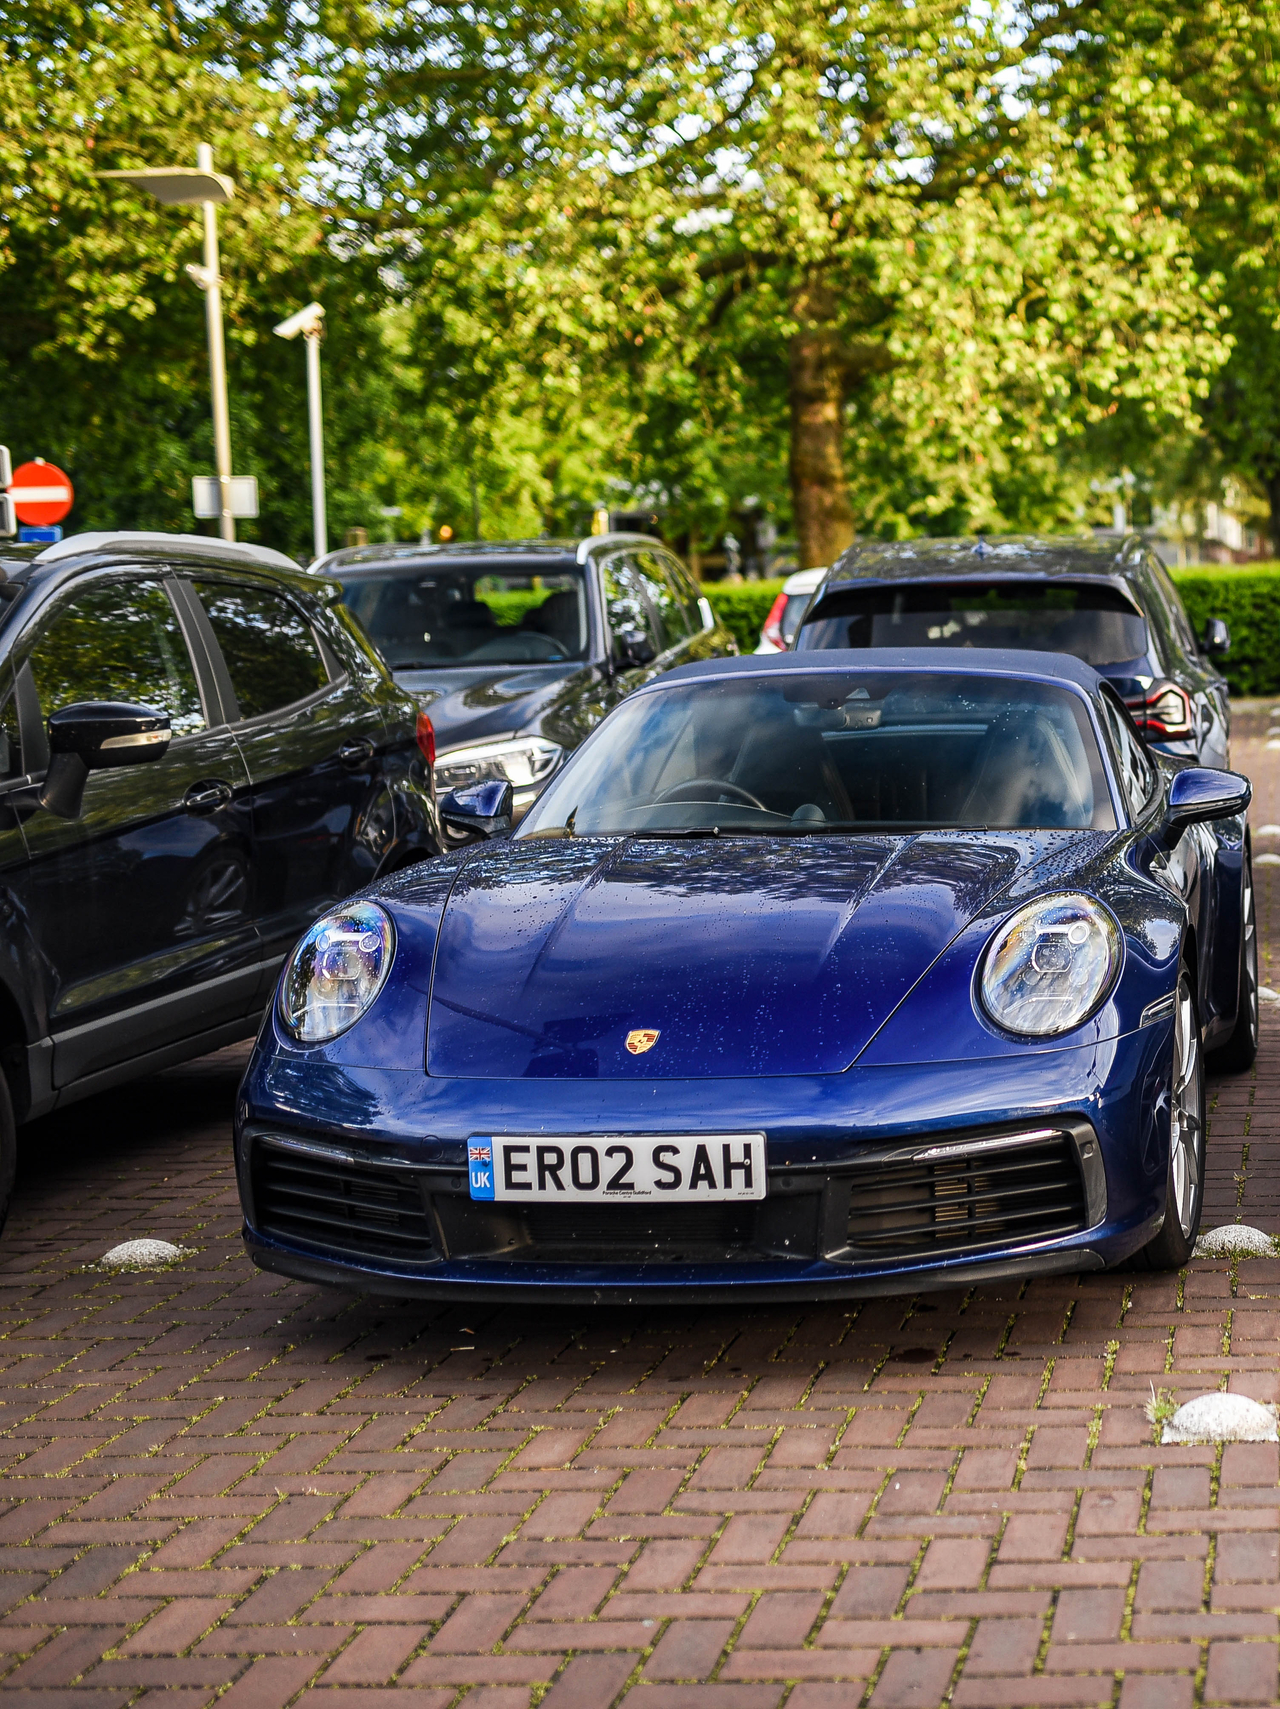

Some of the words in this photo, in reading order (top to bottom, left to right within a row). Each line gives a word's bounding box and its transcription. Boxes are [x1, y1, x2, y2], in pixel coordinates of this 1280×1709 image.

[471, 1172, 491, 1188] UK
[502, 1144, 635, 1191] ER02
[652, 1143, 754, 1191] SAH
